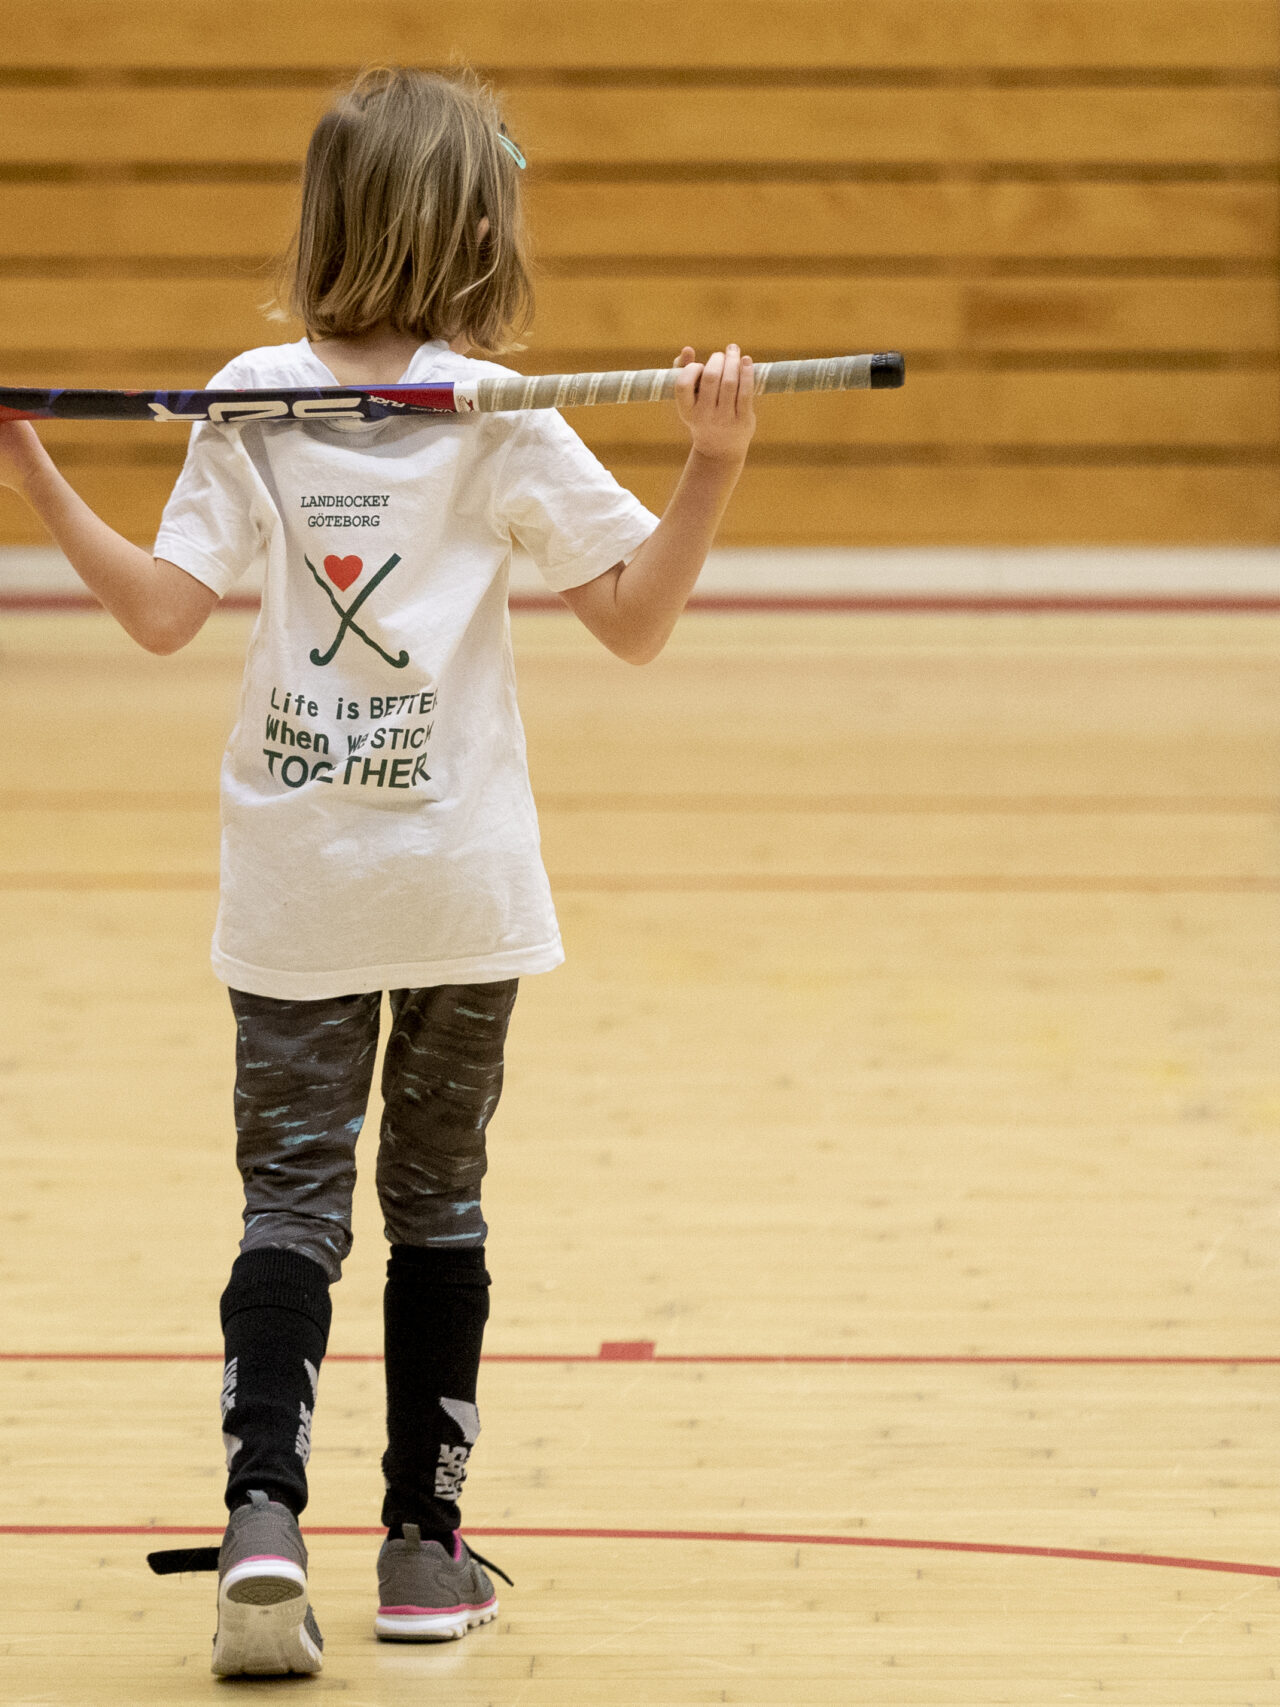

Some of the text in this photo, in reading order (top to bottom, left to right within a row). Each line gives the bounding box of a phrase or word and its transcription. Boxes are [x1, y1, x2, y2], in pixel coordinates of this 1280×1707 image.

[300, 495, 390, 508] LANDHOCKEY
[307, 512, 381, 527] GÖTEBORG
[270, 687, 319, 718] Life
[336, 697, 360, 720] is
[265, 714, 330, 755] When
[370, 720, 435, 750] STICK
[263, 748, 432, 789] TOGTHER
